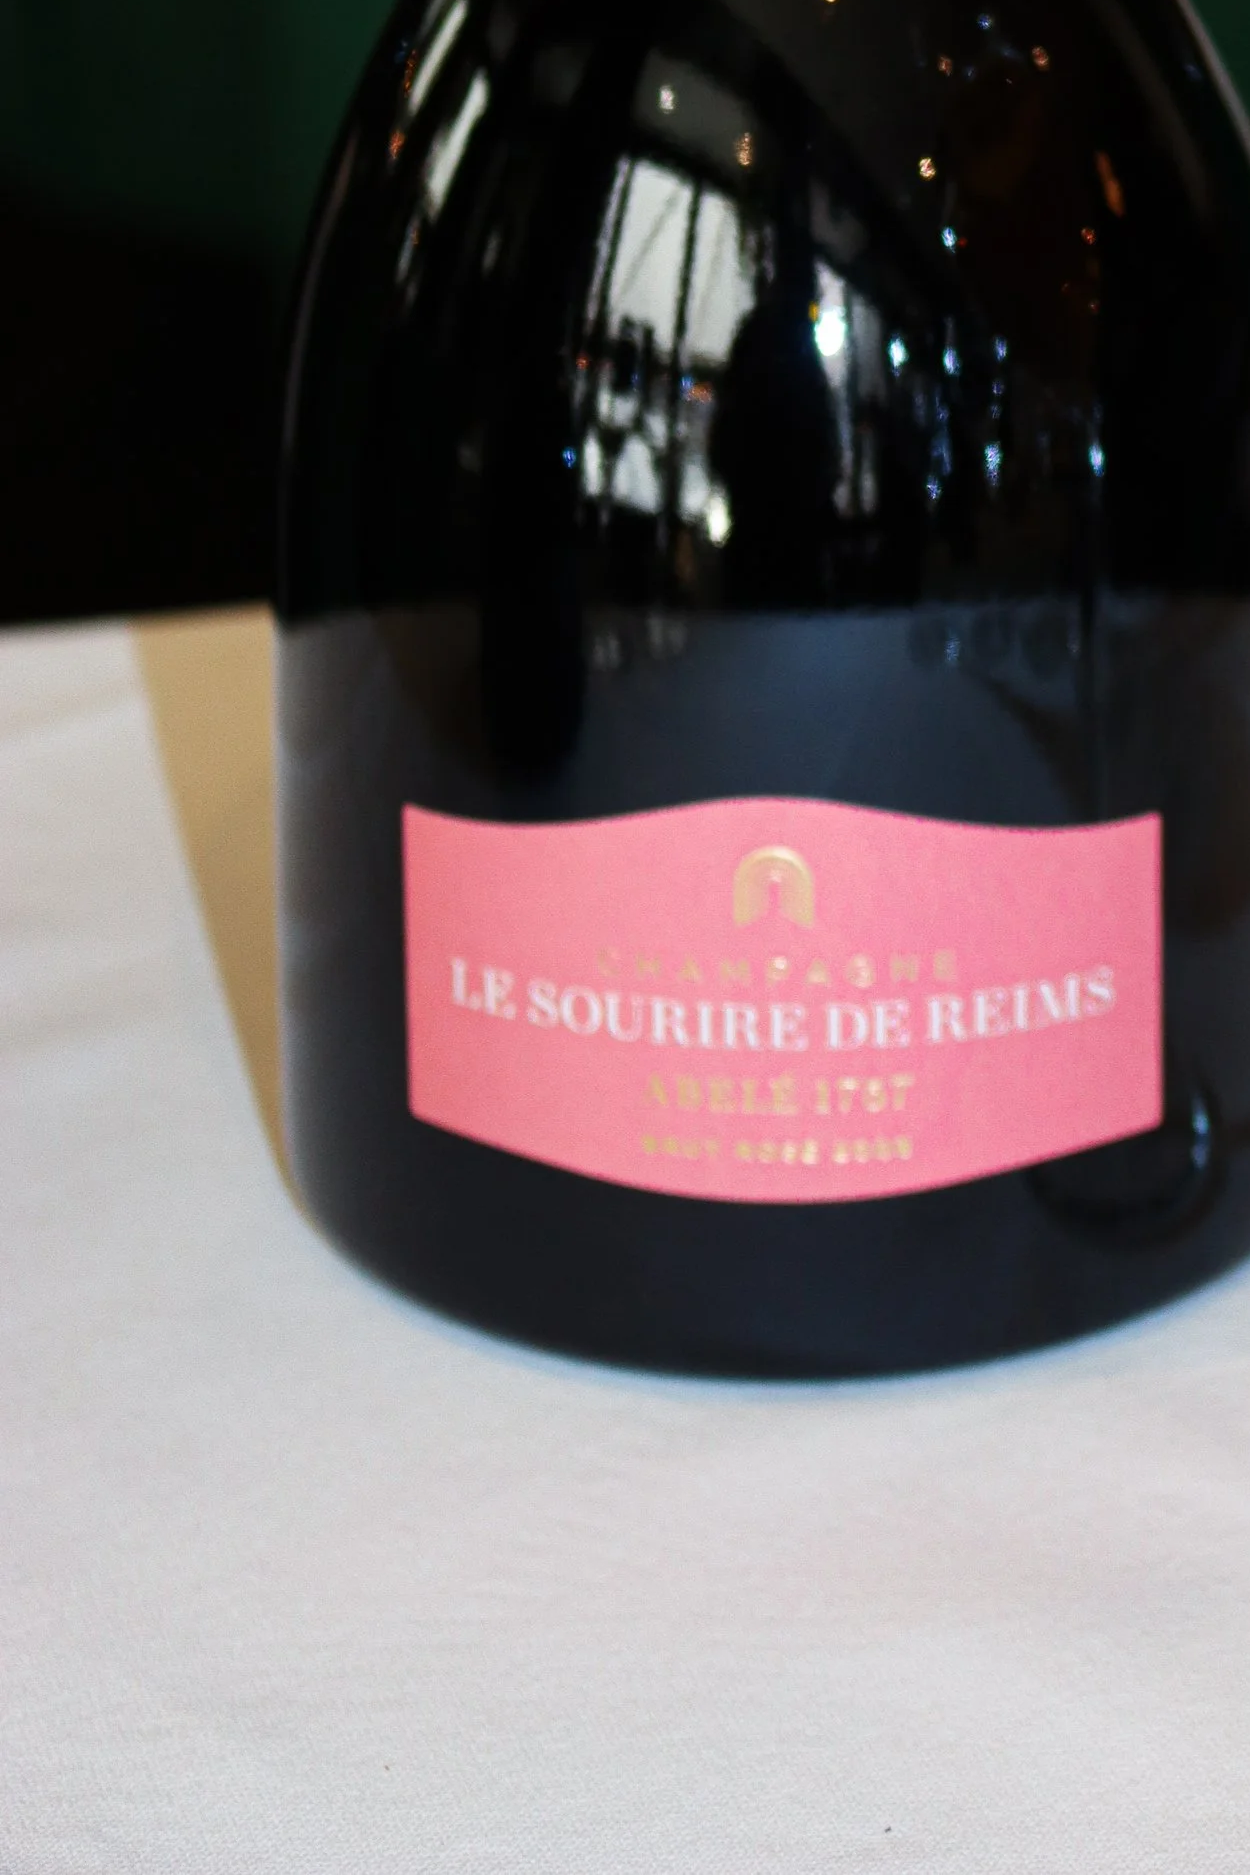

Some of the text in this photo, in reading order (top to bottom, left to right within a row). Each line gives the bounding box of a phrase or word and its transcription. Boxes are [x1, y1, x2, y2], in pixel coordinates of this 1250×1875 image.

[597, 947, 957, 988] CHAMPAGNE
[449, 955, 1118, 1053] LE SOURIRE DE REIMS
